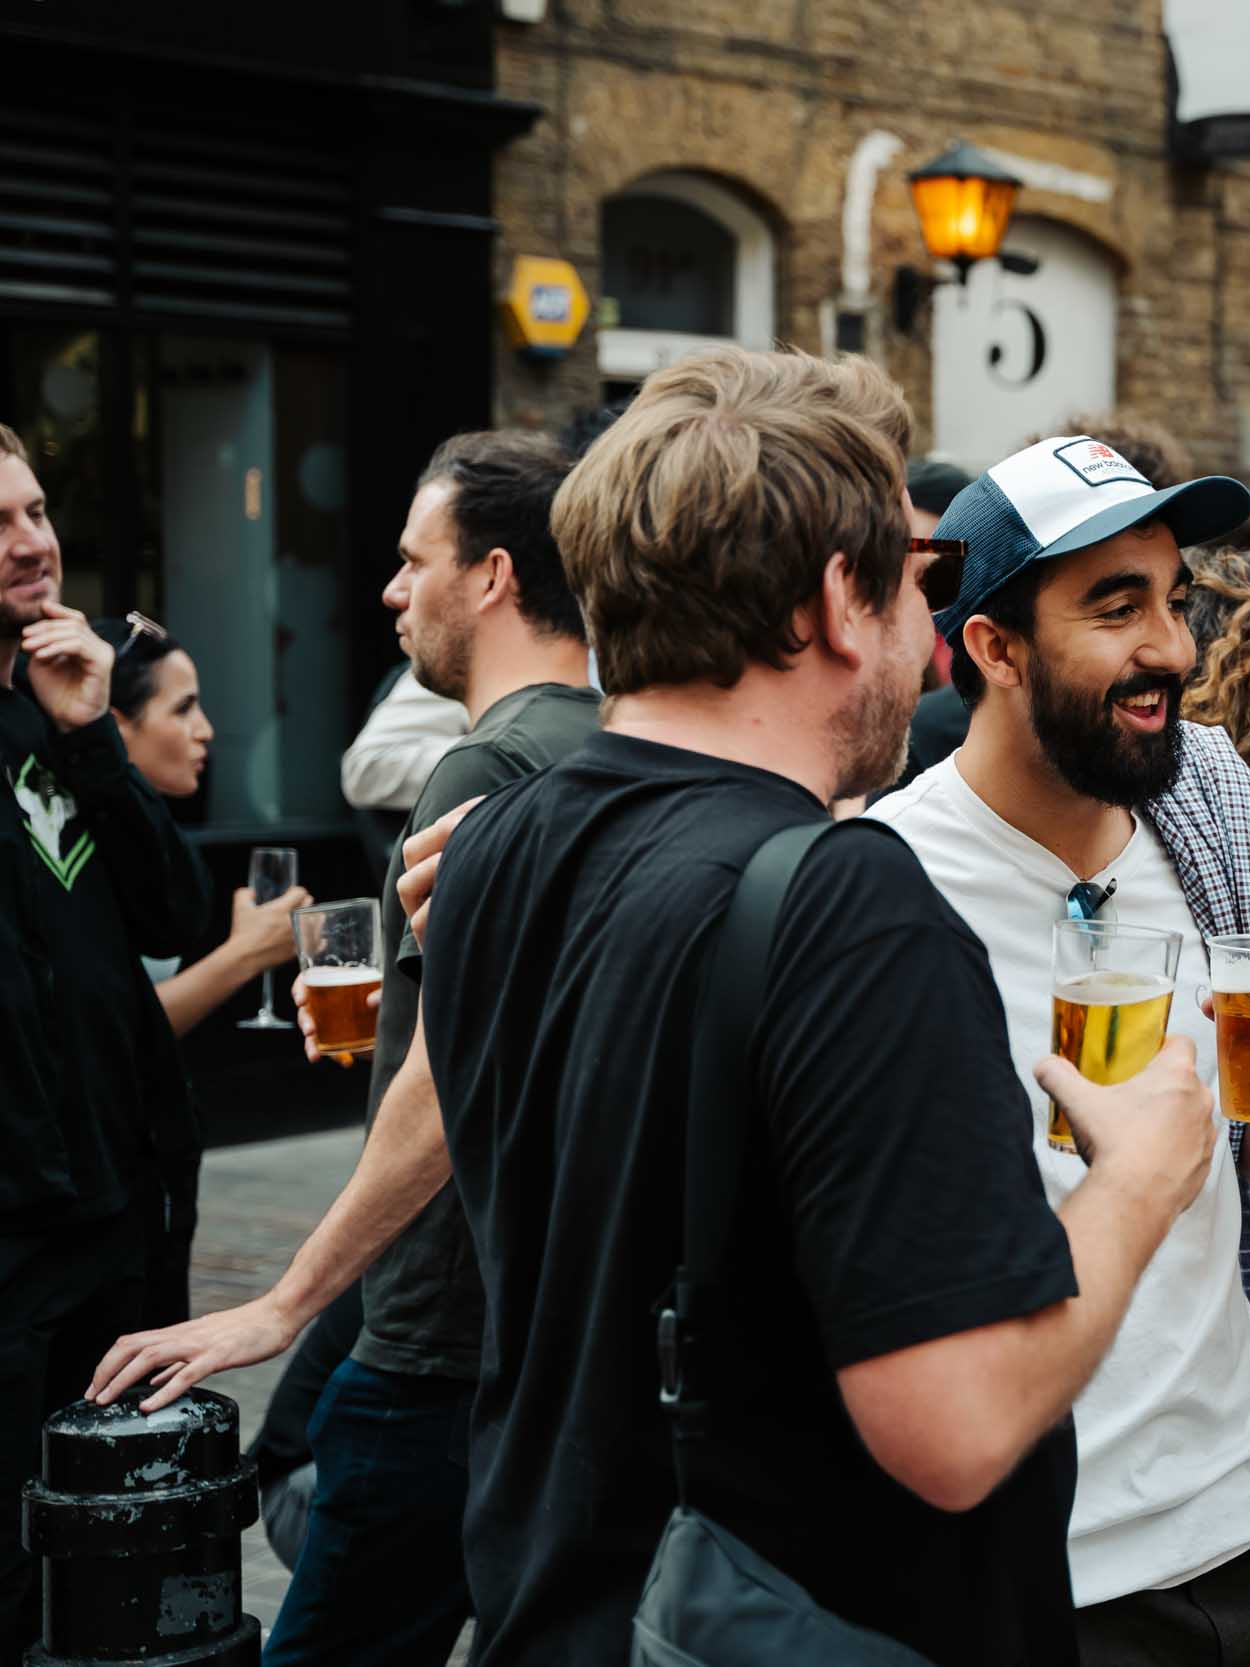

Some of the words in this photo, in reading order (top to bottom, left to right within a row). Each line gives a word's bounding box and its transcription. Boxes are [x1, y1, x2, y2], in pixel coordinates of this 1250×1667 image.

[986, 253, 1047, 389] 5
[1082, 462, 1103, 474] new
[1103, 460, 1134, 471] bala
